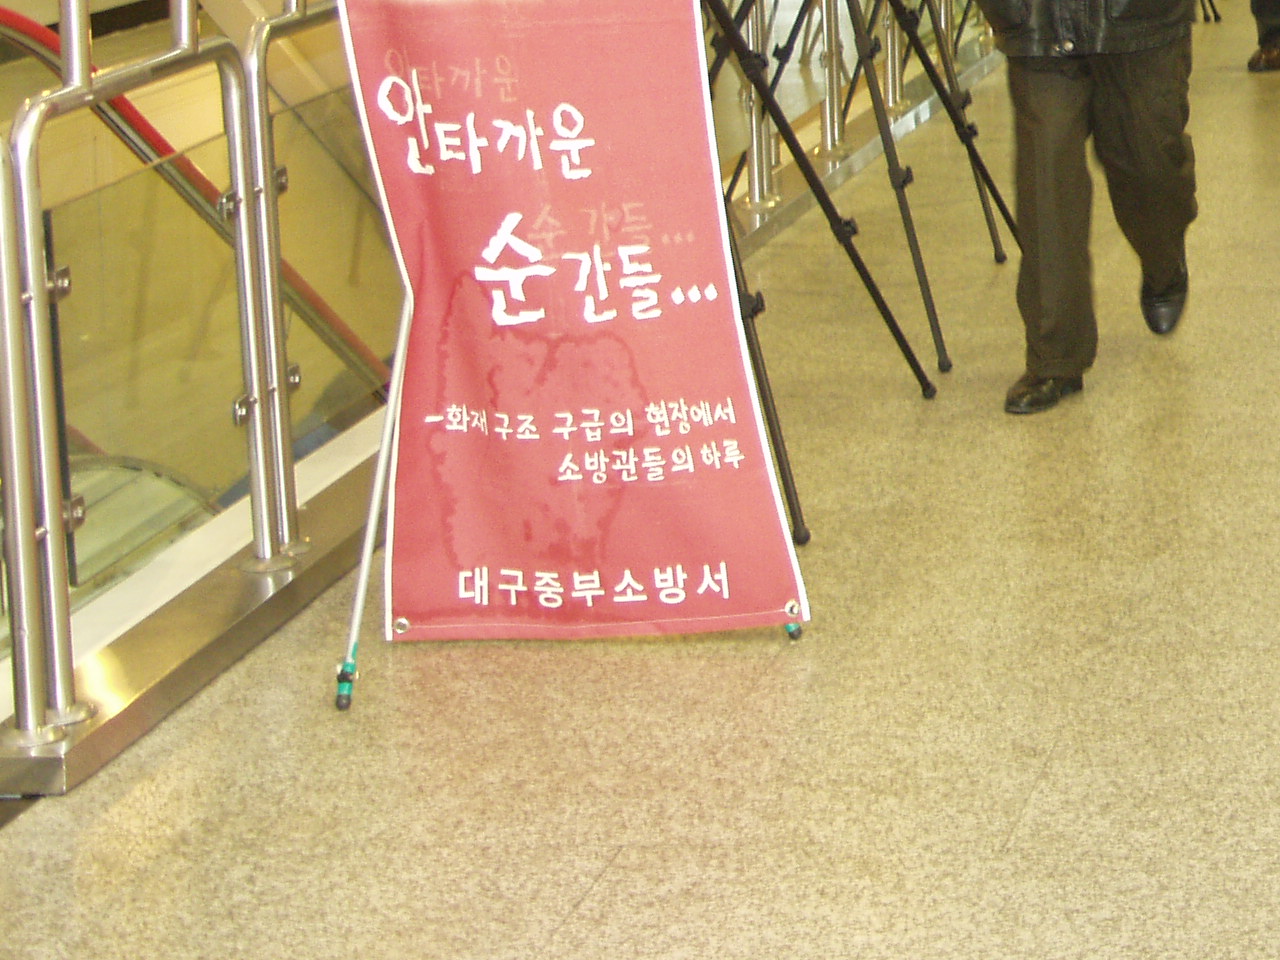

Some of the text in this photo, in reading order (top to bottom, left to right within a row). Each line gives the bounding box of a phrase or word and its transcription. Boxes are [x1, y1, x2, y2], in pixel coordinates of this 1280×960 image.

[377, 68, 595, 180] 안타까운
[552, 408, 634, 442] 구급의
[645, 397, 736, 437] 현장에서
[458, 561, 730, 608] 대구중부소방서
